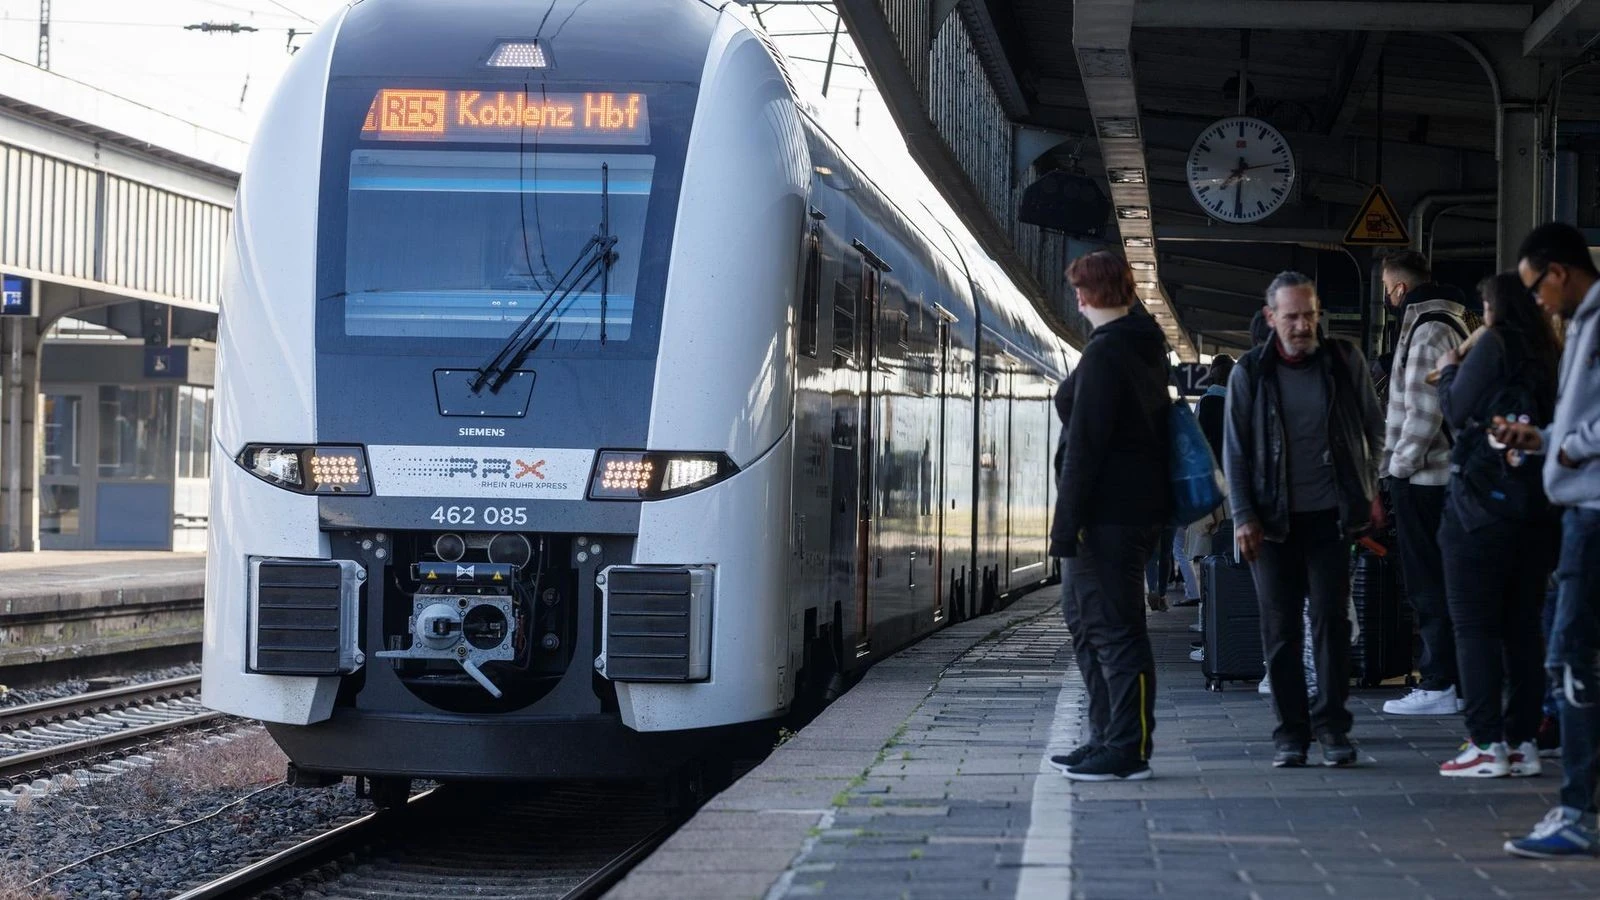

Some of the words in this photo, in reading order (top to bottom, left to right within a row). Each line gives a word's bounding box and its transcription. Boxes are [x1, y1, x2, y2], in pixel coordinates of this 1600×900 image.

[385, 94, 441, 128] RE5
[458, 91, 575, 127] Koblenz
[584, 93, 640, 129] Hbf
[1181, 363, 1211, 390] 12
[458, 427, 506, 437] SIEMENS
[449, 458, 546, 480] RRX
[481, 481, 507, 489] RHEIN
[509, 481, 534, 489] RUHR
[535, 482, 568, 490] XPRESS
[430, 505, 475, 524] 462
[483, 506, 528, 525] 085
